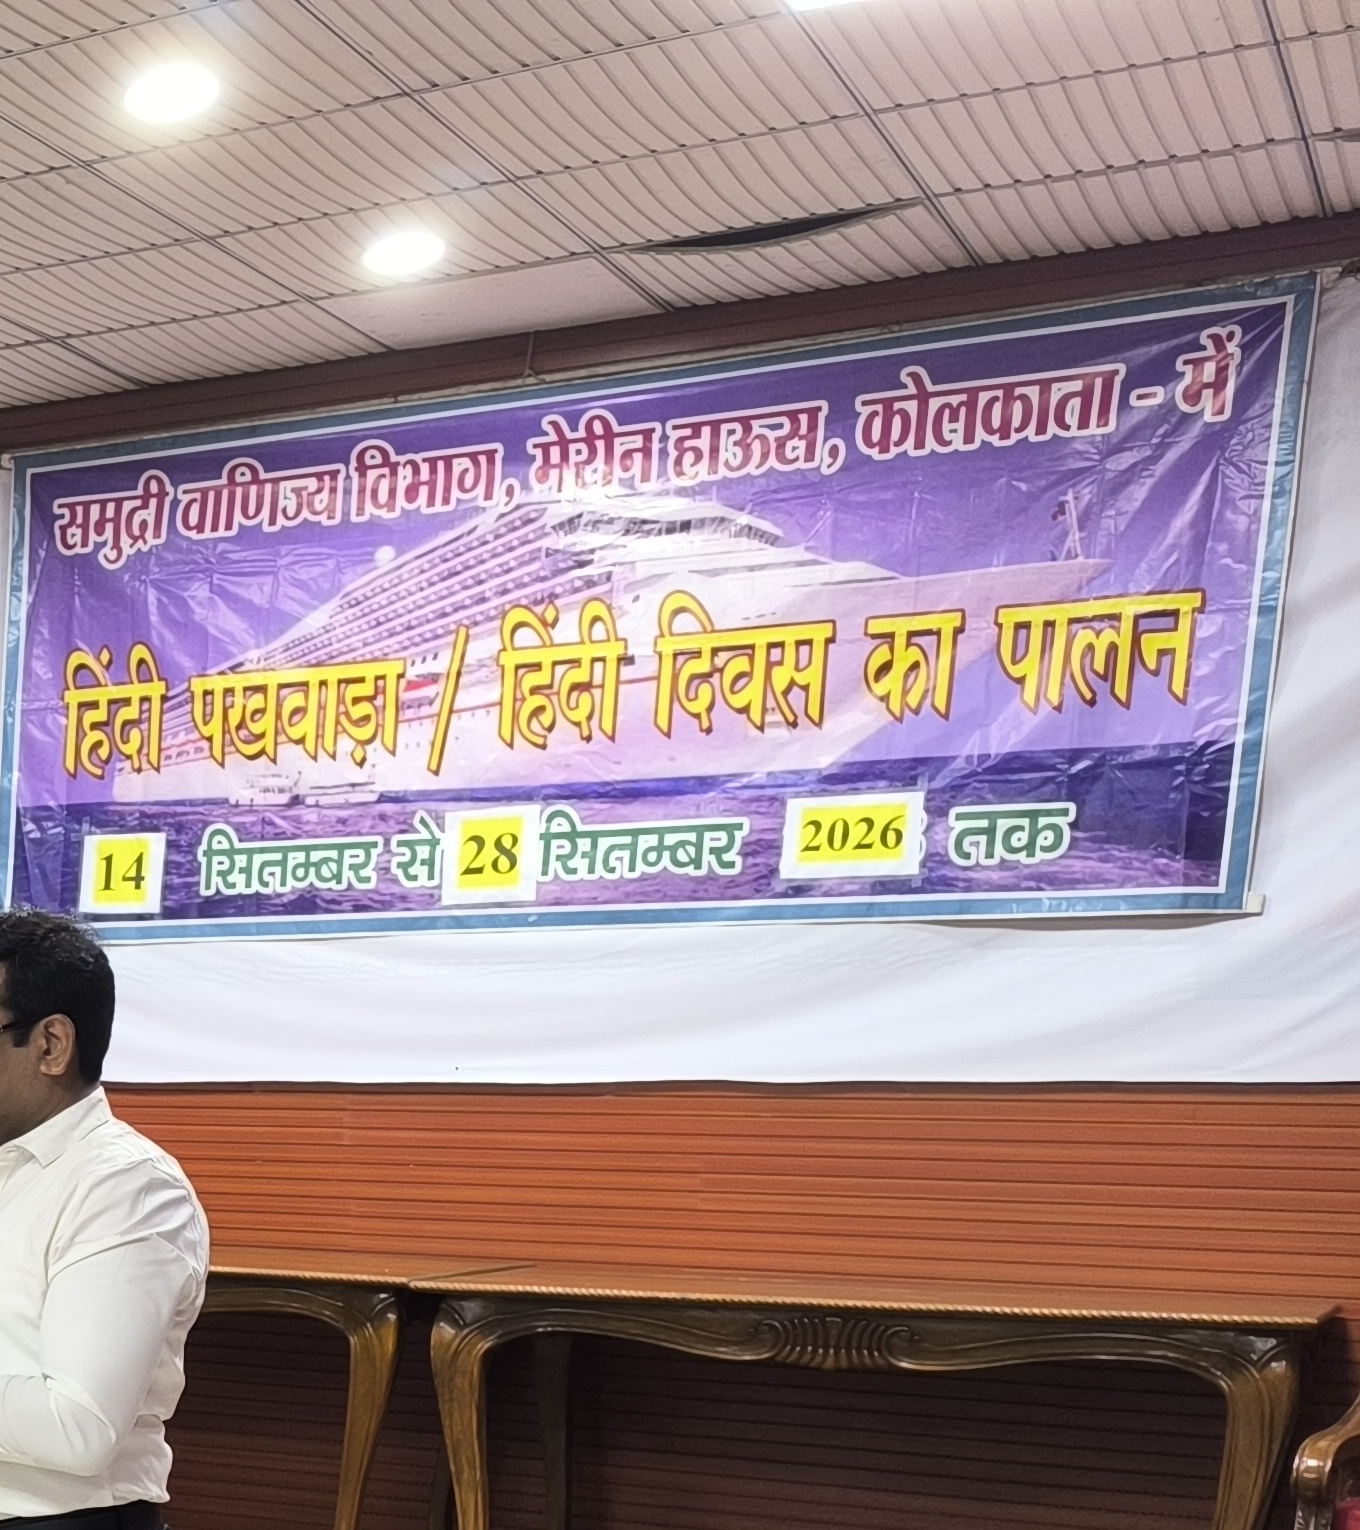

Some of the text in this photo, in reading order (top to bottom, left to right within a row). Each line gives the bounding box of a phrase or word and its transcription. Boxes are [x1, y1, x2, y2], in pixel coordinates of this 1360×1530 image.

[57, 474, 170, 565] समुद्री
[181, 462, 341, 534] वाणिज्य
[355, 444, 515, 517] विभाग,
[532, 414, 656, 493] मेरीन
[671, 405, 841, 481] हाऊस,
[861, 371, 1121, 455] कोलकाता
[1183, 330, 1238, 417] में
[62, 643, 166, 778] हिंदी
[191, 659, 406, 768] पखवाड़ा
[497, 599, 627, 748] हिंदी
[654, 589, 836, 737] दिवस
[864, 608, 965, 721] का
[995, 587, 1206, 716] पालन
[99, 805, 1072, 892] 14 सितम्बर से 28 सितम्बर 2026 तक
